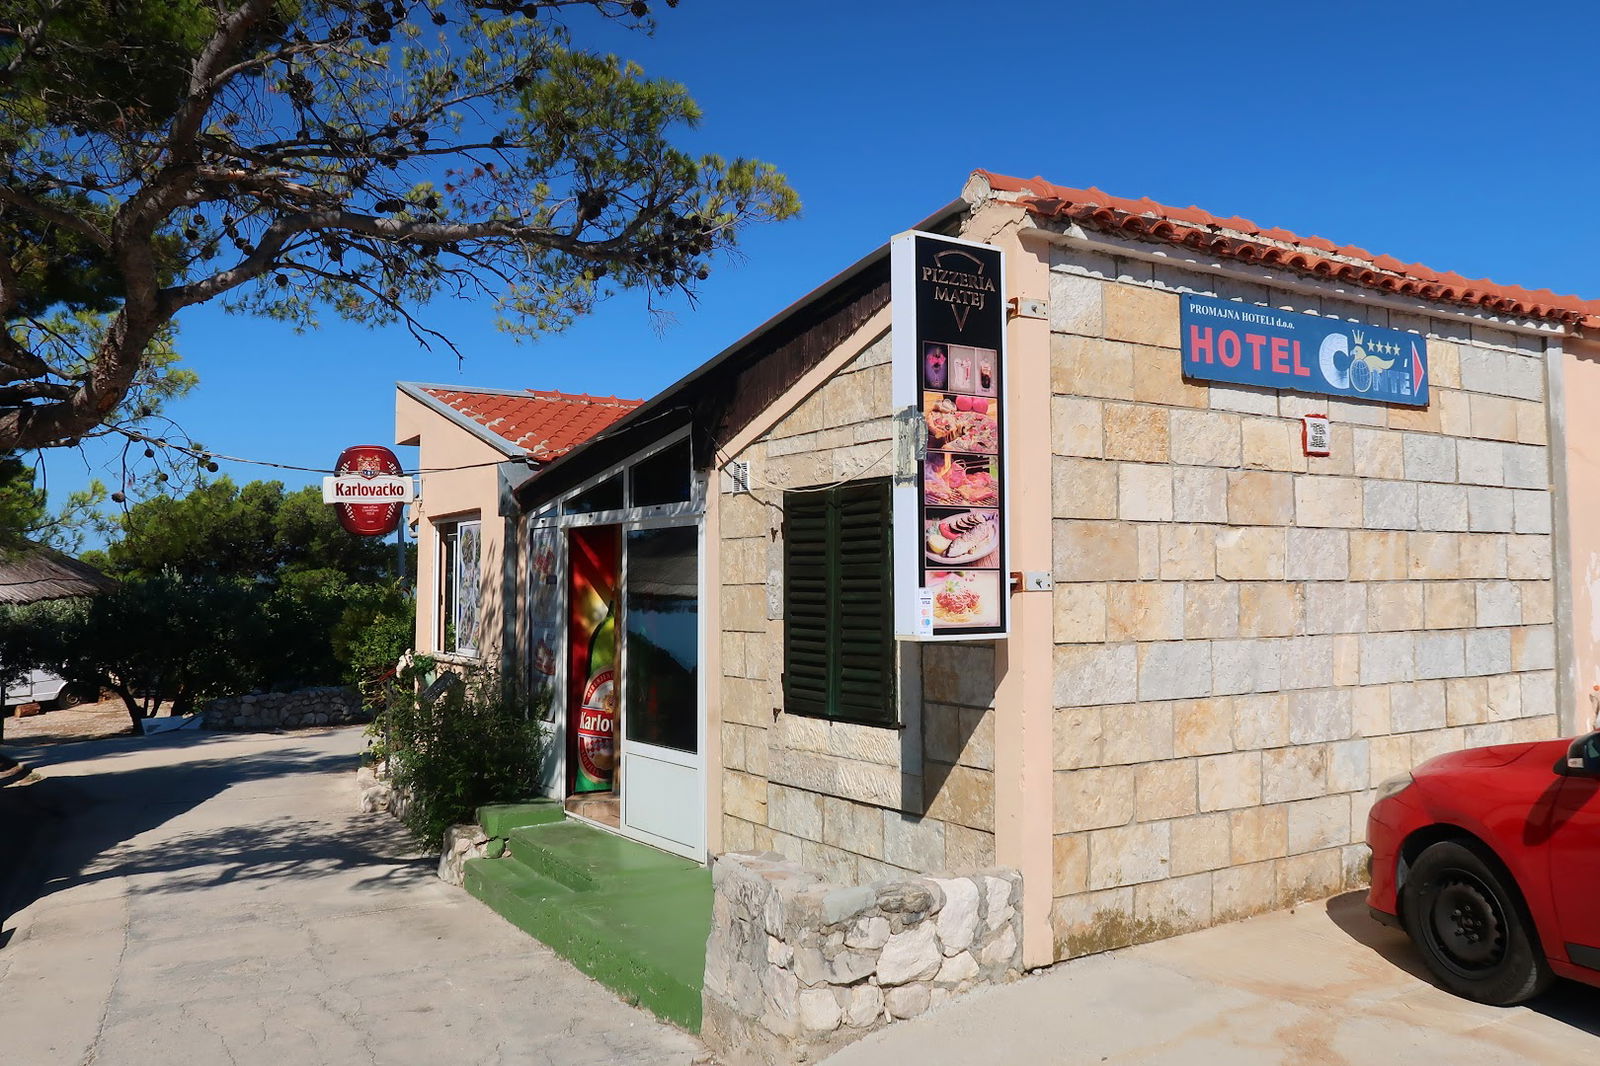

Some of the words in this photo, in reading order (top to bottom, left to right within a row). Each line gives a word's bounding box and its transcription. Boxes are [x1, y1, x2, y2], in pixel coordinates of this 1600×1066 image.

[922, 266, 996, 292] PIZZERIA
[934, 286, 985, 310] MATEJ
[1189, 303, 1241, 321] PROMAJNA
[1241, 311, 1275, 326] HOTELI
[1190, 324, 1311, 377] HOTEL
